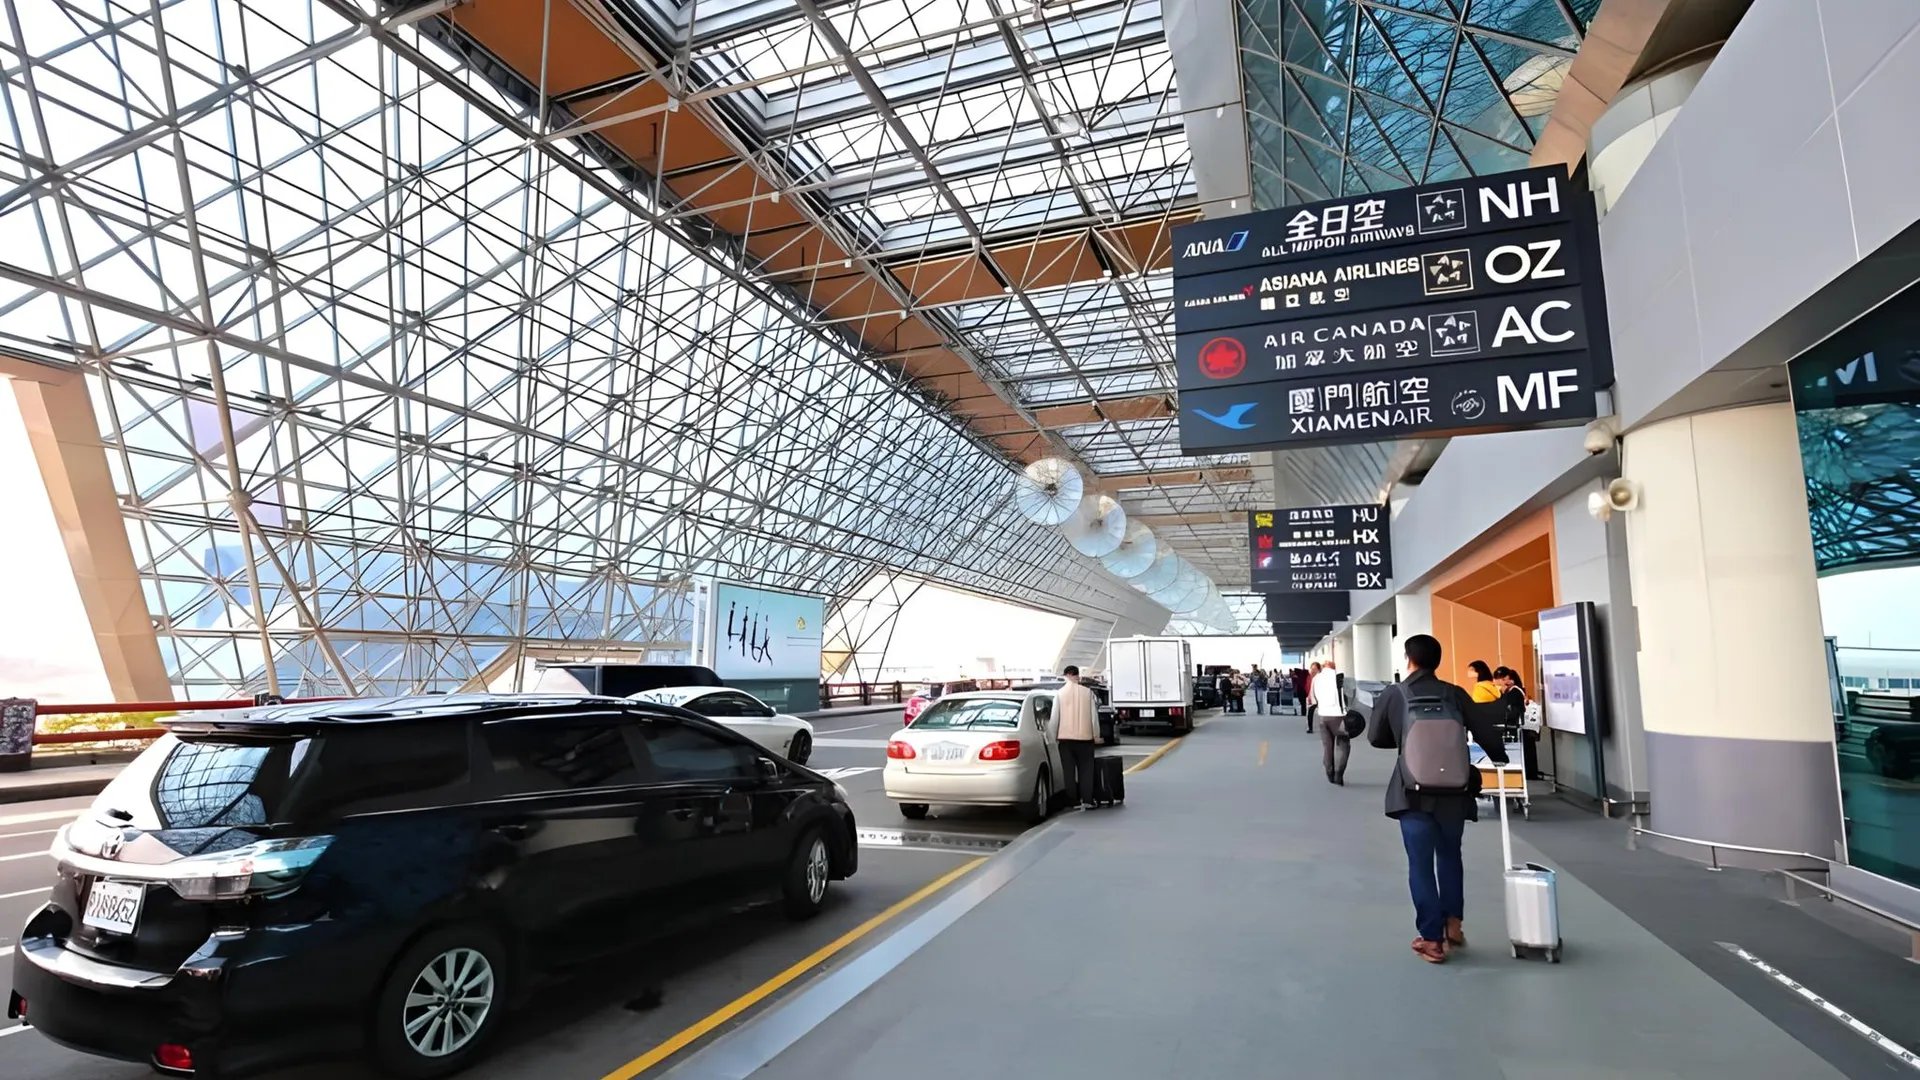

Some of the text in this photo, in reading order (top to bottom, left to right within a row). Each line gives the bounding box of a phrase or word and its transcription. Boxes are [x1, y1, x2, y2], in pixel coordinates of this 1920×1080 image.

[1479, 177, 1560, 223] NH
[1285, 199, 1386, 242] 全日空
[1182, 238, 1225, 258] ANA
[1485, 239, 1566, 284] OZ
[1260, 257, 1420, 292] ASIANA AIRLINES
[1264, 317, 1426, 349] AIR CANADA
[1491, 300, 1576, 348] AC
[1497, 368, 1579, 413] MF
[1291, 406, 1433, 434] XIAMENAIR
[1352, 507, 1378, 523] HU
[1353, 528, 1380, 545] HX
[1355, 550, 1382, 566] NS
[1356, 572, 1382, 588] BX
